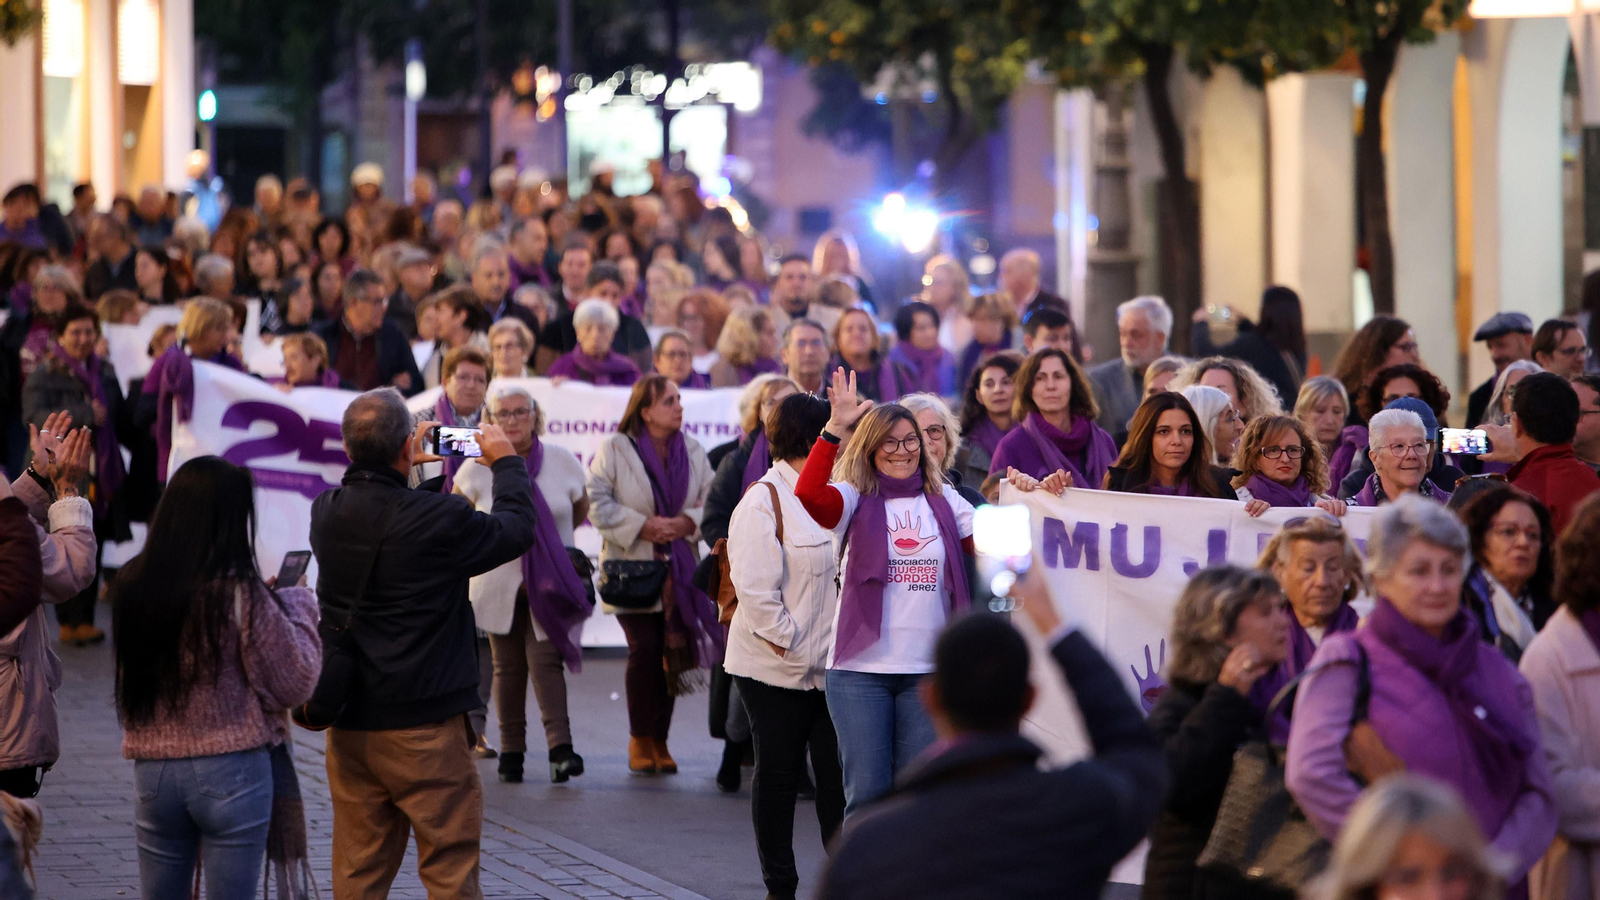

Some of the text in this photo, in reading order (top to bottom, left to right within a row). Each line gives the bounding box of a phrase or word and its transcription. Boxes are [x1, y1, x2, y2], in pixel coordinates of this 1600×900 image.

[221, 401, 351, 492] 25
[548, 420, 742, 436] CIONA NTRA
